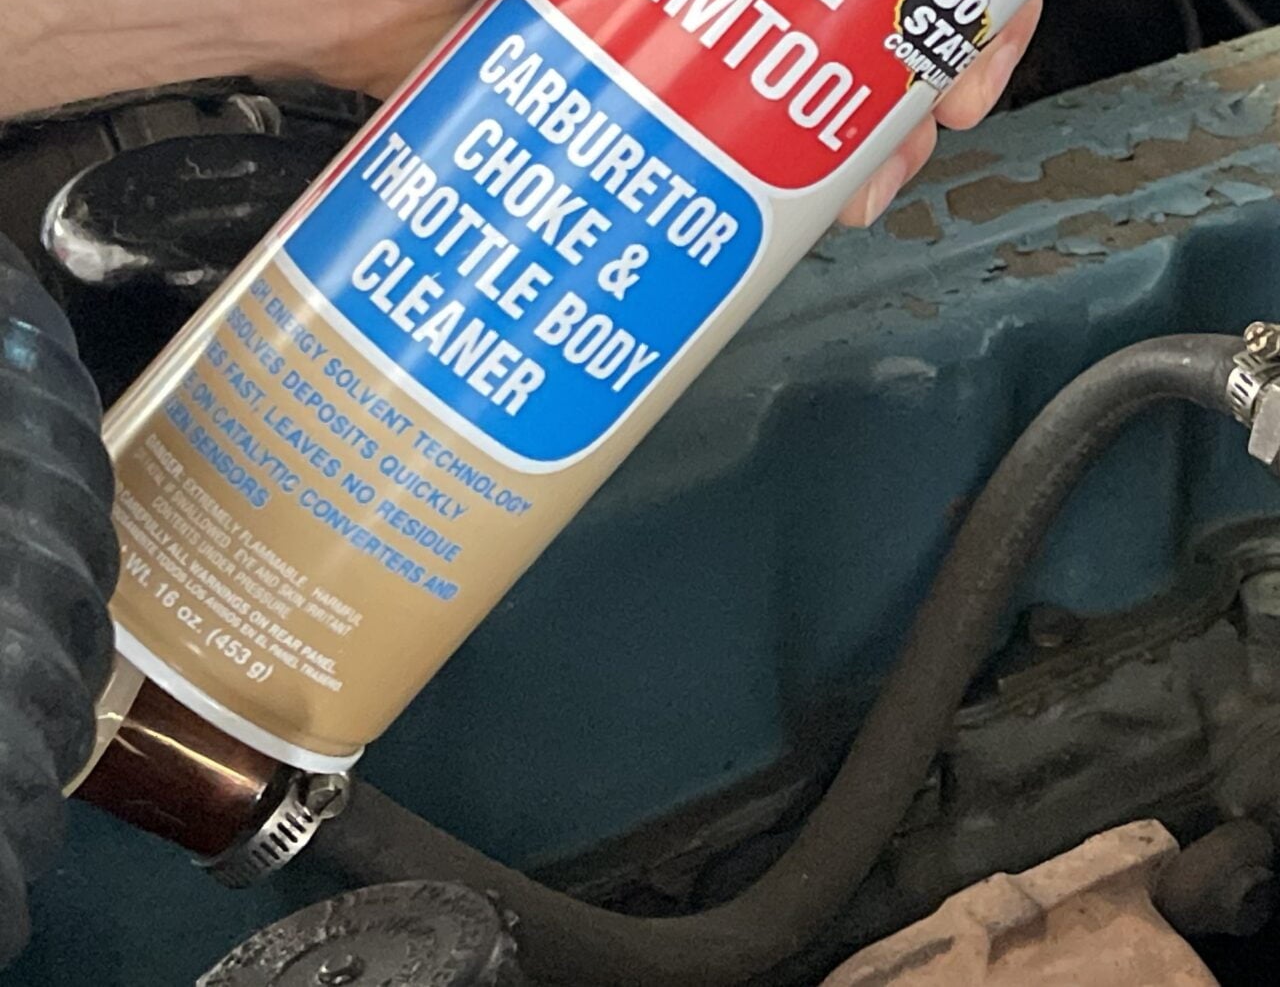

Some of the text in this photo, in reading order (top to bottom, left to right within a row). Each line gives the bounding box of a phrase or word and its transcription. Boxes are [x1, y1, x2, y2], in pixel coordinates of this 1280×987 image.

[453, 118, 650, 301] CHOKE &
[478, 33, 739, 267] CARBURETOR
[350, 238, 546, 417] CLEANER
[361, 132, 661, 393] THROTTLE BODY
[190, 426, 268, 507] SENSORS
[224, 361, 462, 562] FAST, LEAVES NO RESIDUE
[265, 297, 328, 361] ENERGY
[323, 357, 414, 435] SOLVENT
[413, 430, 533, 516] TECHNOLOGY
[281, 369, 379, 460] DEPOSITS
[379, 455, 469, 520] QUICKLY
[152, 496, 200, 545] CONTENTS
[198, 541, 236, 577] UNDER
[182, 478, 241, 534] EXTREMELY
[312, 587, 363, 628] HARMFUL
[191, 383, 459, 601] ON CATALYTIC CONVERTERS AND
[127, 552, 273, 683] Wt. 16 oz. (453 g)
[167, 543, 188, 565] ALL
[190, 560, 251, 614] WARNINGS
[250, 611, 270, 629] ON
[268, 624, 303, 651] REAR
[185, 579, 207, 600] LOS
[233, 548, 257, 570] EYE
[255, 567, 280, 587] AND
[278, 583, 306, 608] SKIN
